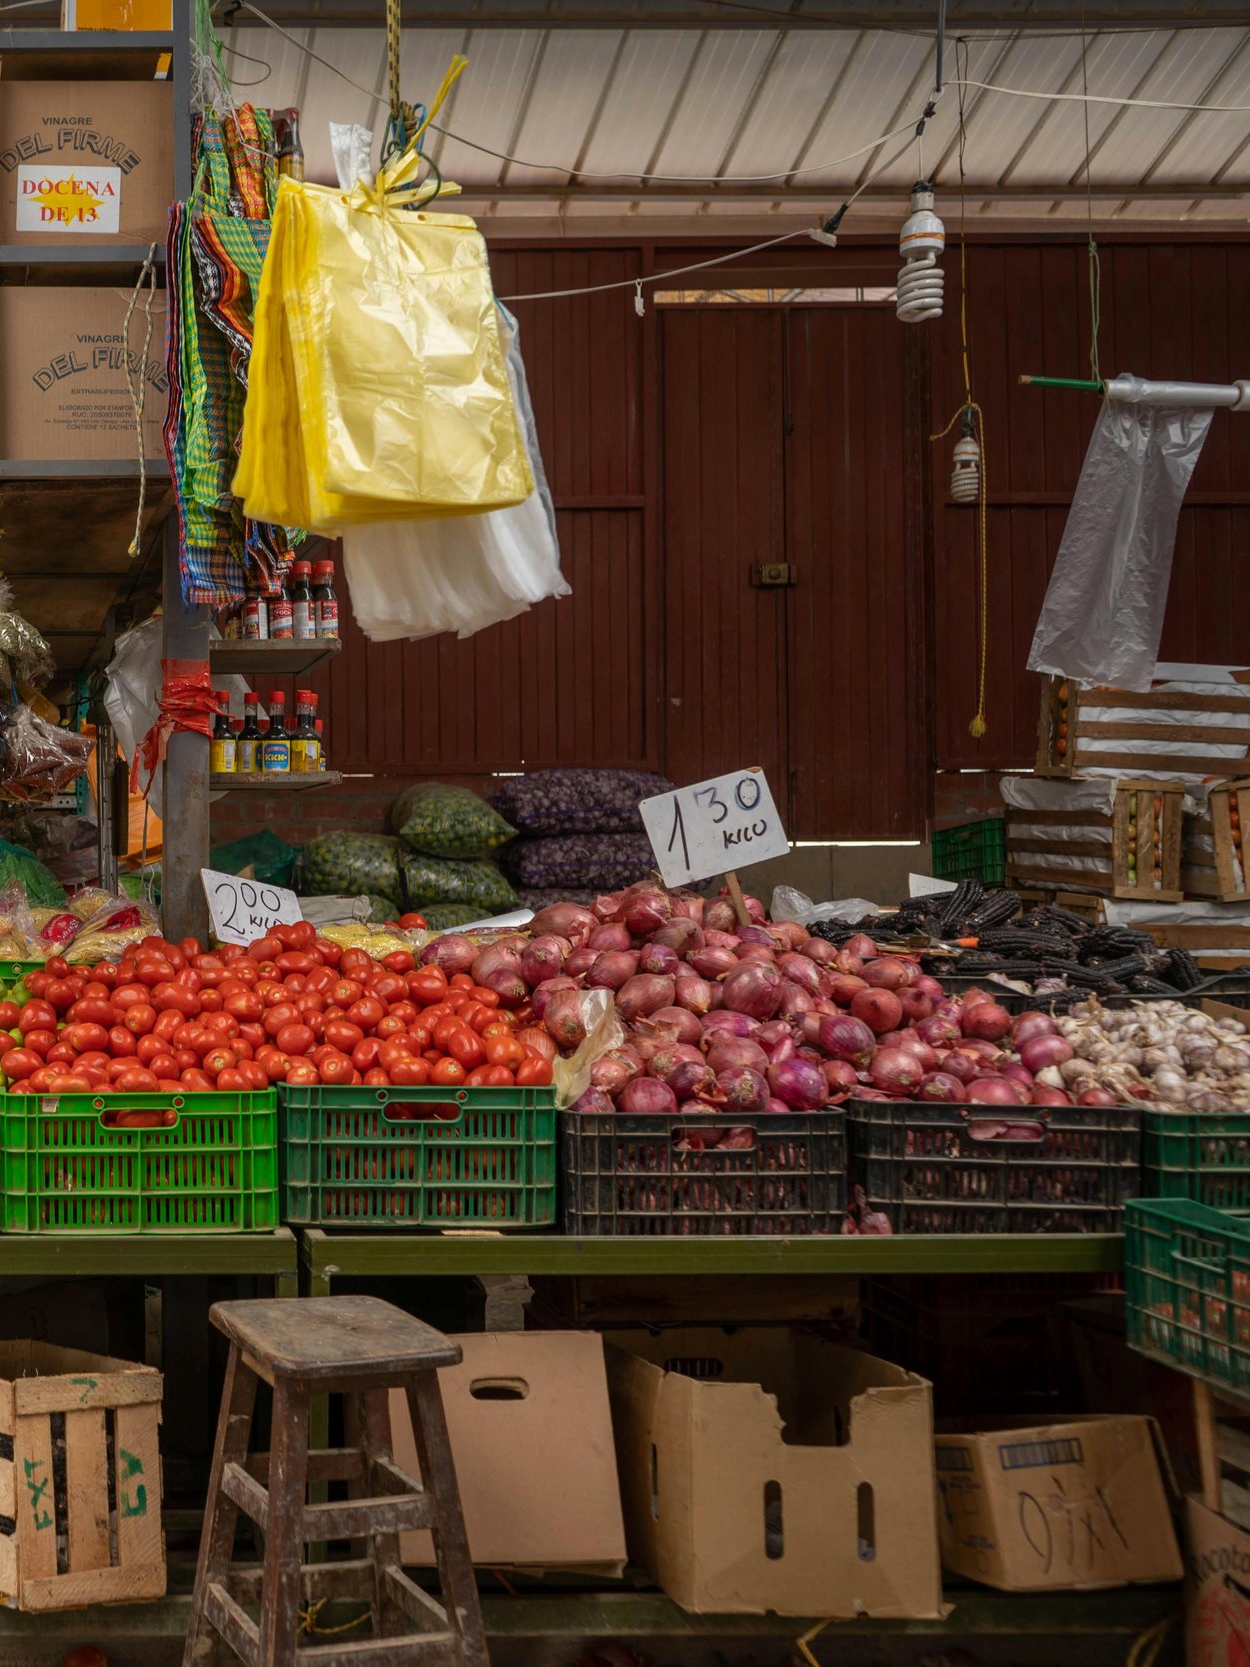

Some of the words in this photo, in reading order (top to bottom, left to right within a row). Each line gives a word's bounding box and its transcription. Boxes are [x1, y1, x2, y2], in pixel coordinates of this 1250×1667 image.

[42, 117, 93, 125] VINAGRE
[58, 129, 141, 175] FIRME
[22, 180, 116, 196] DOCENA
[41, 206, 69, 222] DE
[77, 207, 97, 222] 13
[33, 351, 89, 391] DEL
[93, 347, 170, 394] FIRME
